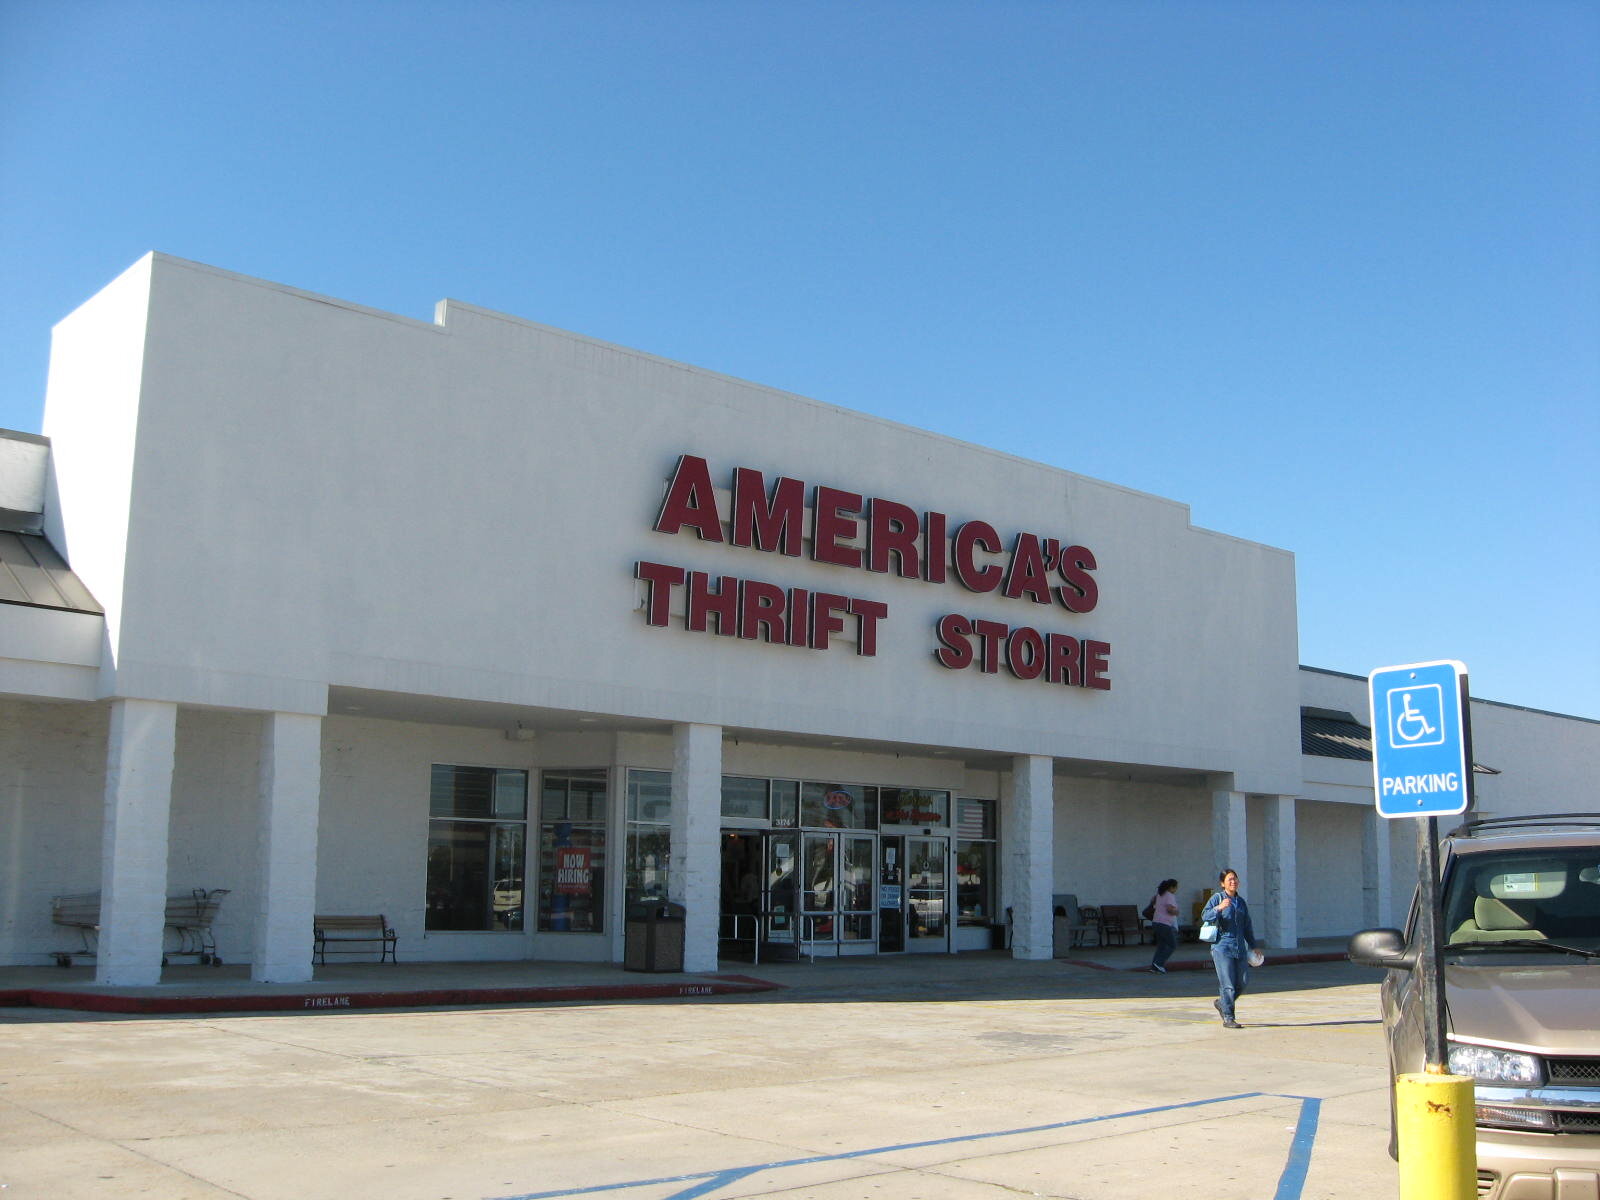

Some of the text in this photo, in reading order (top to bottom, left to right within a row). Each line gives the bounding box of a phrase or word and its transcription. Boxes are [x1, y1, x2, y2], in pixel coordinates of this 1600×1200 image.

[654, 455, 1098, 613] AMERICA'S
[635, 561, 1111, 690] THRIFT STORE
[1382, 772, 1458, 796] PARKING
[564, 854, 584, 867] NOW
[558, 869, 589, 882] HIRING
[304, 996, 350, 1006] FIRELANE
